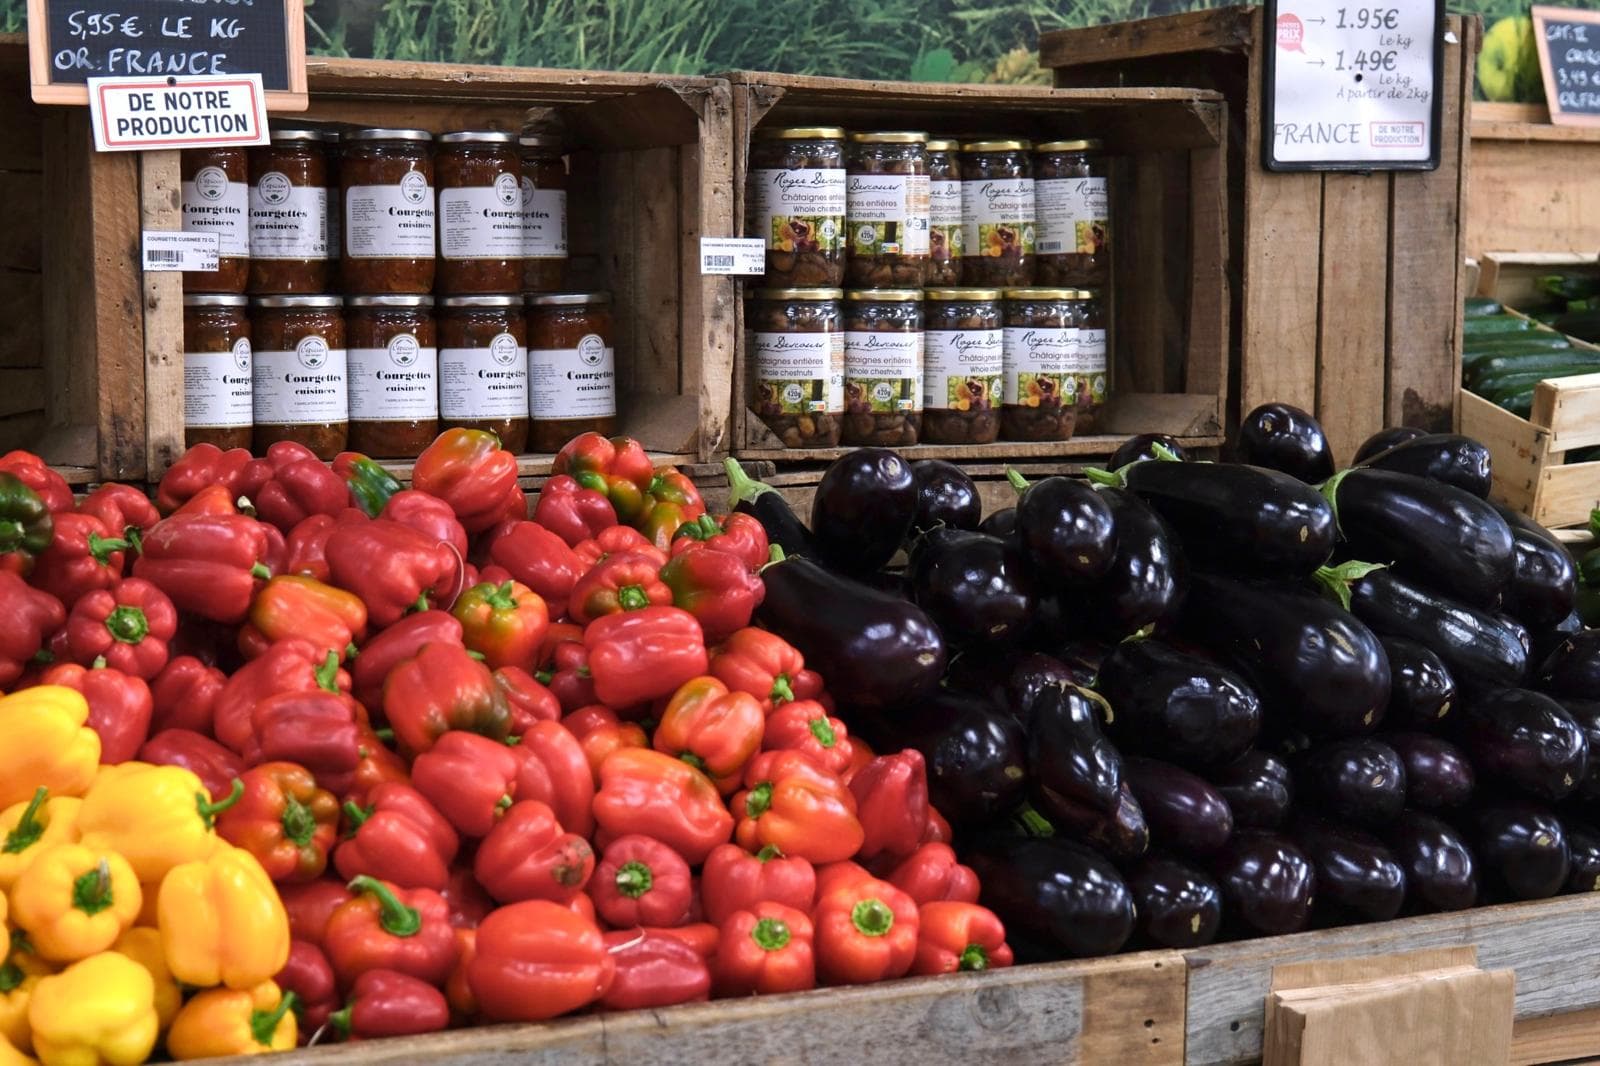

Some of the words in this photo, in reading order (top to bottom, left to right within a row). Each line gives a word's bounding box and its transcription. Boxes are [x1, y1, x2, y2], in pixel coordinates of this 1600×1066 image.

[1335, 7, 1399, 30] 1.95€
[161, 17, 193, 38] LE
[210, 18, 246, 38] KG
[1379, 34, 1394, 46] Le
[1396, 34, 1413, 49] kg
[108, 48, 227, 75] FRANCE
[1335, 49, 1398, 71] 1.49€
[1379, 73, 1394, 85] Le
[1396, 73, 1413, 88] kg
[128, 93, 156, 112] DE
[164, 91, 231, 110] NOTRE
[1347, 86, 1385, 102] partir
[1387, 86, 1402, 99] de
[1406, 87, 1430, 103] 2kg
[117, 114, 248, 137] PRODUCTION
[1378, 125, 1389, 134] DE
[1390, 125, 1415, 134] NOTRE
[1274, 122, 1362, 145] FRANCE
[1374, 135, 1420, 144] PRODUCTION
[781, 193, 827, 203] Châtaignes
[182, 203, 241, 216] Courgettes
[793, 357, 824, 365] entières
[285, 373, 341, 384] Courgettes
[376, 370, 431, 381] Courgettes
[870, 368, 902, 376] chestnuts
